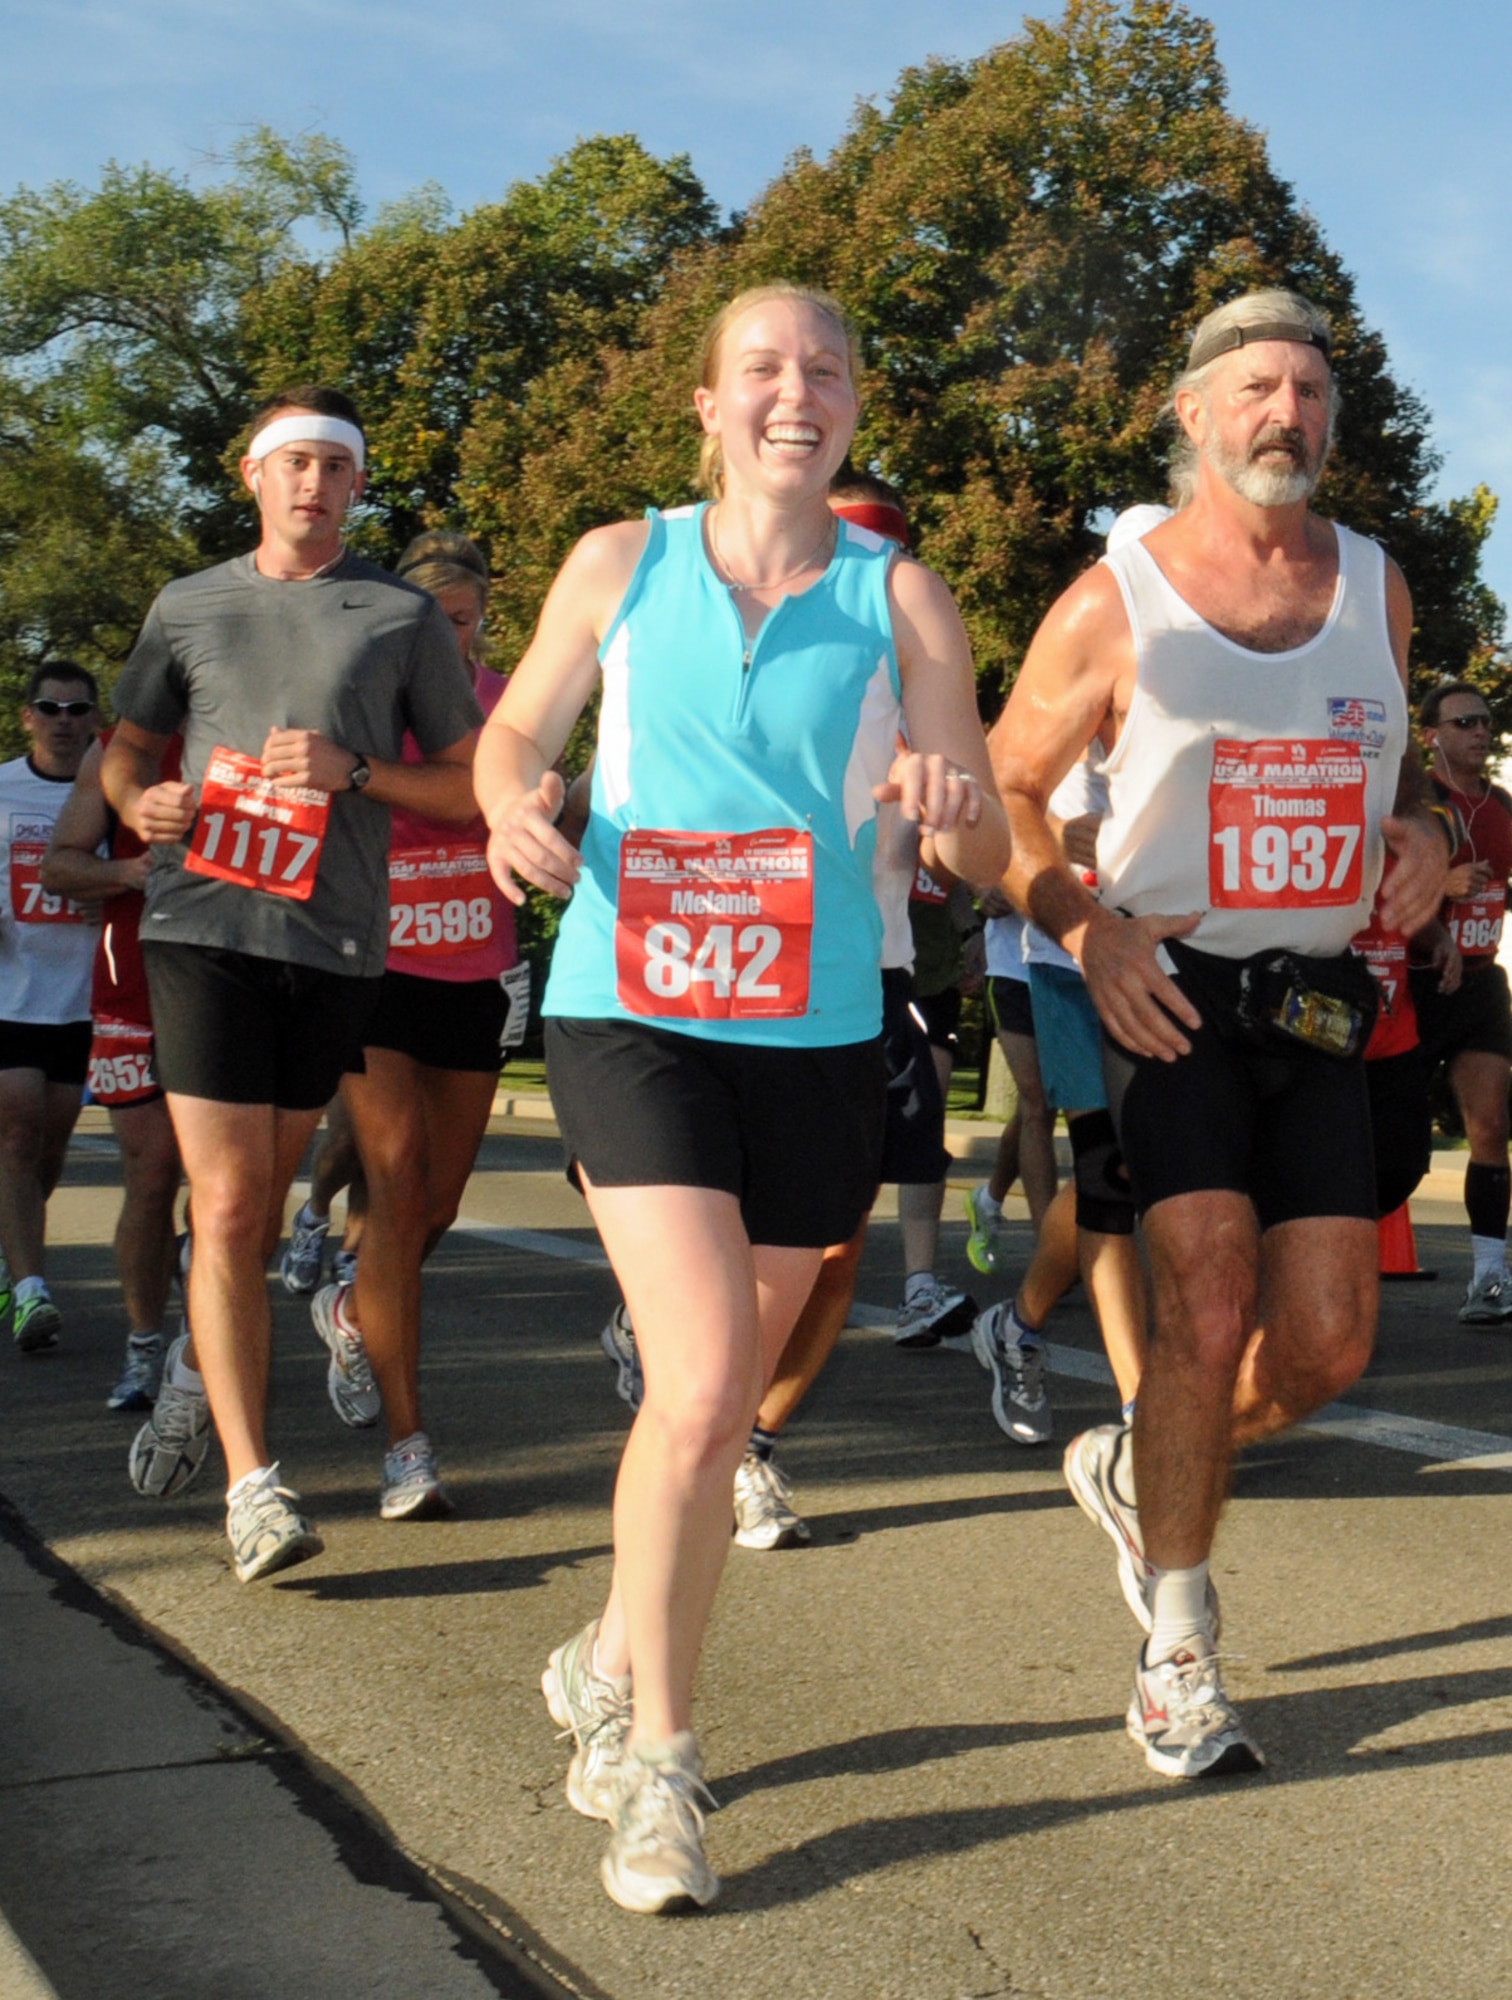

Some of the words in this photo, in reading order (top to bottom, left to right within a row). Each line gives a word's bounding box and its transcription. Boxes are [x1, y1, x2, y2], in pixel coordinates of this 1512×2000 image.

[209, 766, 245, 782] USAF
[1214, 763, 1259, 778] USAF
[1264, 763, 1364, 778] MARATHON
[1251, 794, 1327, 818] Thomas
[202, 812, 319, 882] 1117
[1213, 824, 1362, 893] 1937
[626, 856, 678, 871] USAF
[683, 856, 808, 871] MARATHON
[670, 890, 761, 916] Melanie
[390, 898, 493, 947] 2598
[1448, 918, 1503, 949] 1964
[643, 921, 783, 999] 842
[88, 1053, 157, 1094] 2652
